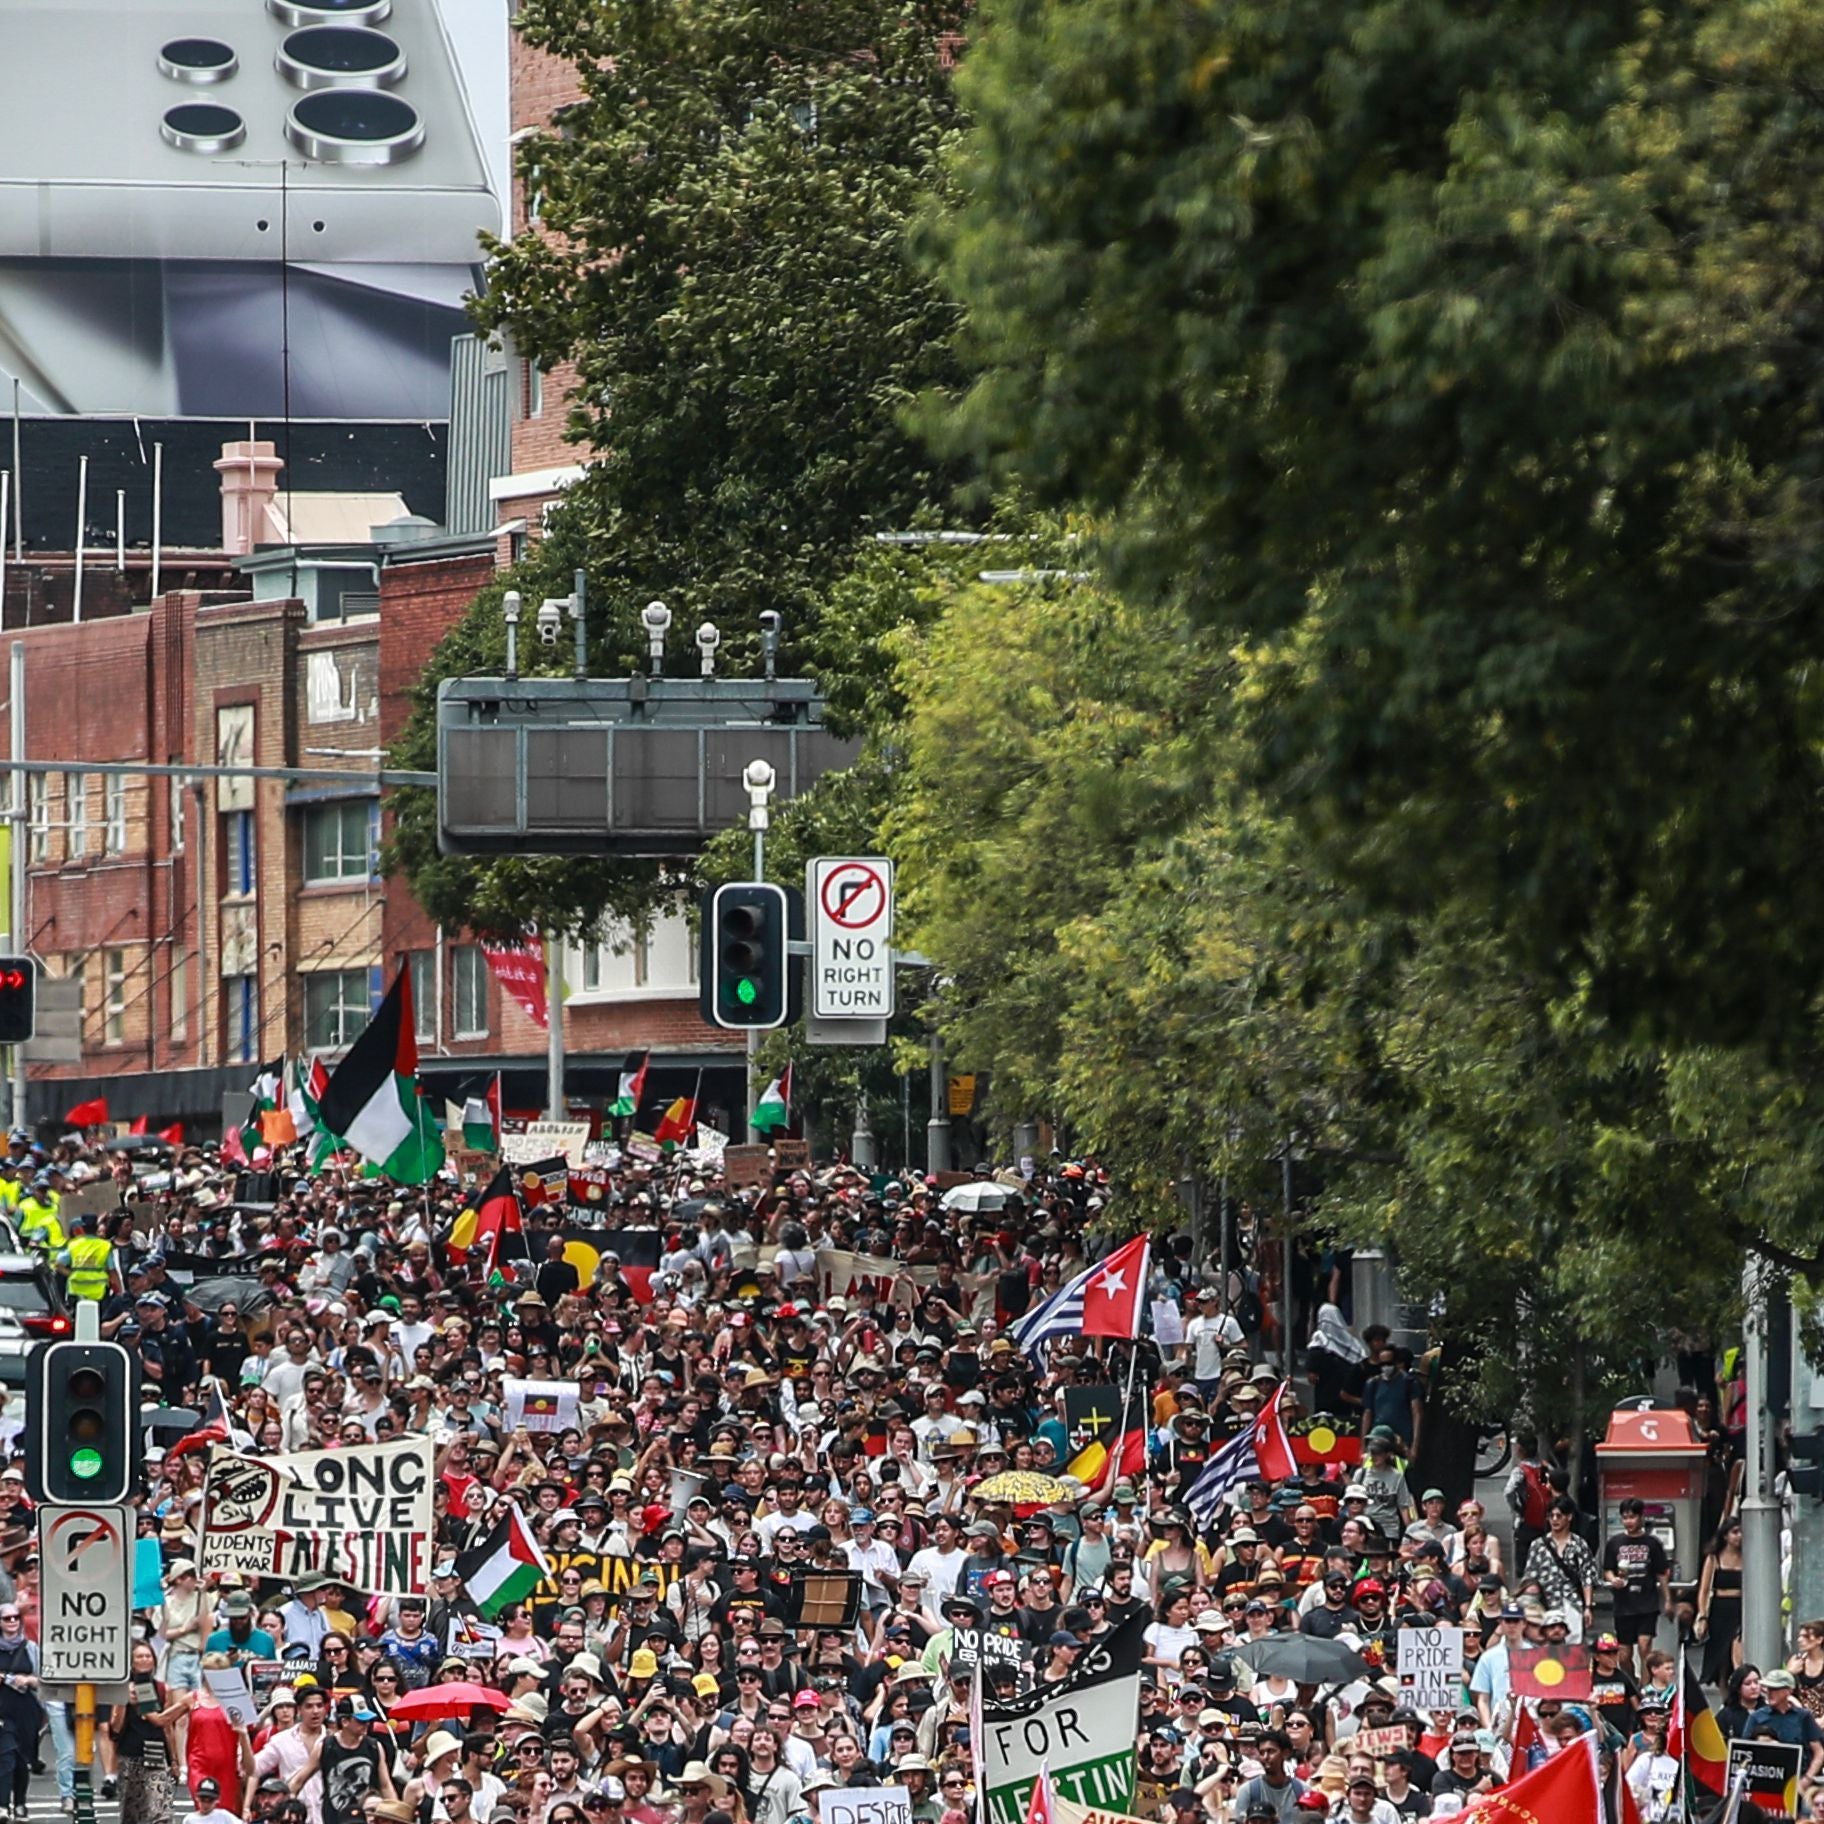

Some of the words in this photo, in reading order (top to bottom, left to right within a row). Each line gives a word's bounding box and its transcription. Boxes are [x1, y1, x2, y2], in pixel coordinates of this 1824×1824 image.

[832, 937, 875, 961] NO
[823, 967, 884, 984] RIGHT
[826, 989, 883, 1007] TURN
[288, 1451, 427, 1495] LONG
[282, 1493, 416, 1529] LIVE
[235, 1554, 272, 1573] WAR
[61, 1591, 107, 1618] NO
[50, 1624, 119, 1643] RIGHT
[1415, 1629, 1443, 1647] NO
[954, 1627, 979, 1650] NO
[983, 1632, 1024, 1661] PRIDE
[52, 1651, 115, 1670] TURN
[1404, 1647, 1454, 1668] PRIDE
[1419, 1670, 1442, 1688] IN
[994, 1707, 1091, 1767] FOR
[1356, 1726, 1405, 1750] JEWS
[1729, 1777, 1754, 1791] DY
